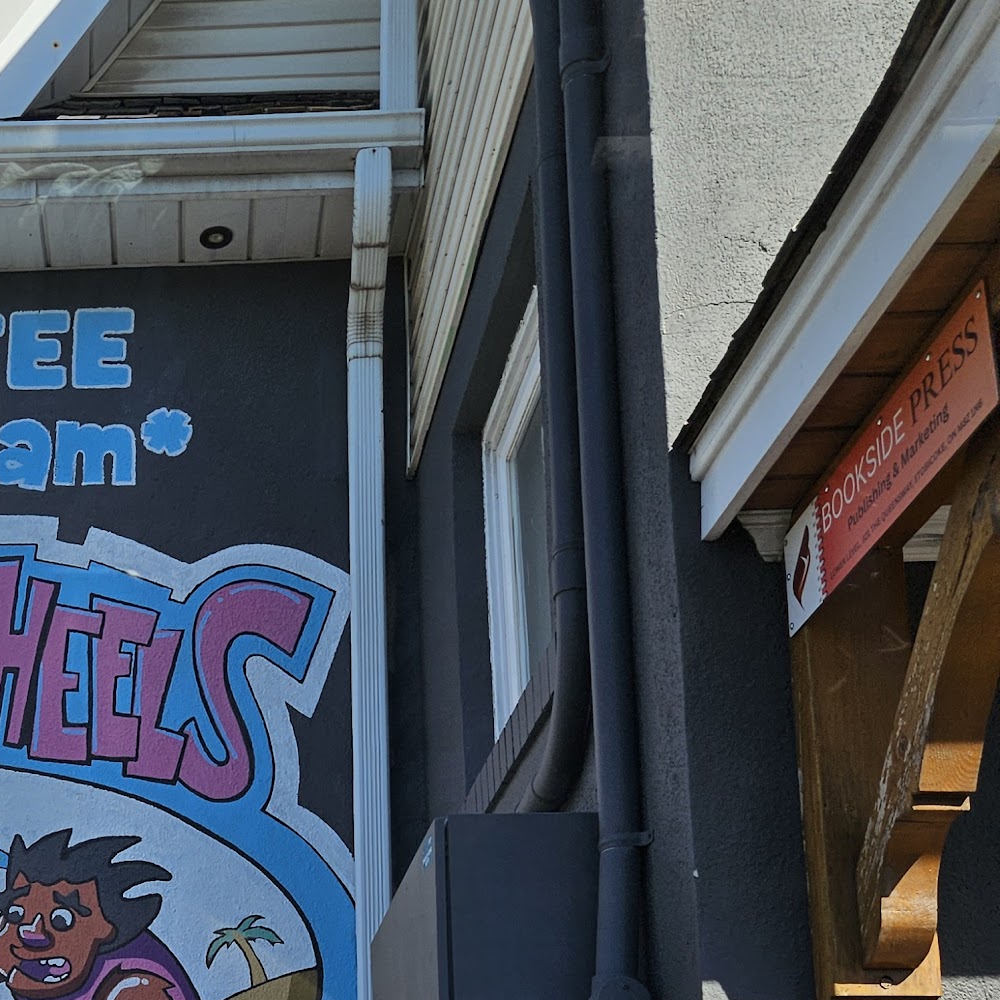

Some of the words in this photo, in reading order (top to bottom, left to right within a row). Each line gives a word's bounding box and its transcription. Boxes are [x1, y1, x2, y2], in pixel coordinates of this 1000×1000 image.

[821, 408, 906, 533] BOOKSIDE
[909, 315, 978, 426] PRESS
[846, 470, 893, 531] Publishing
[892, 462, 900, 478] &
[900, 403, 950, 470] Marketing
